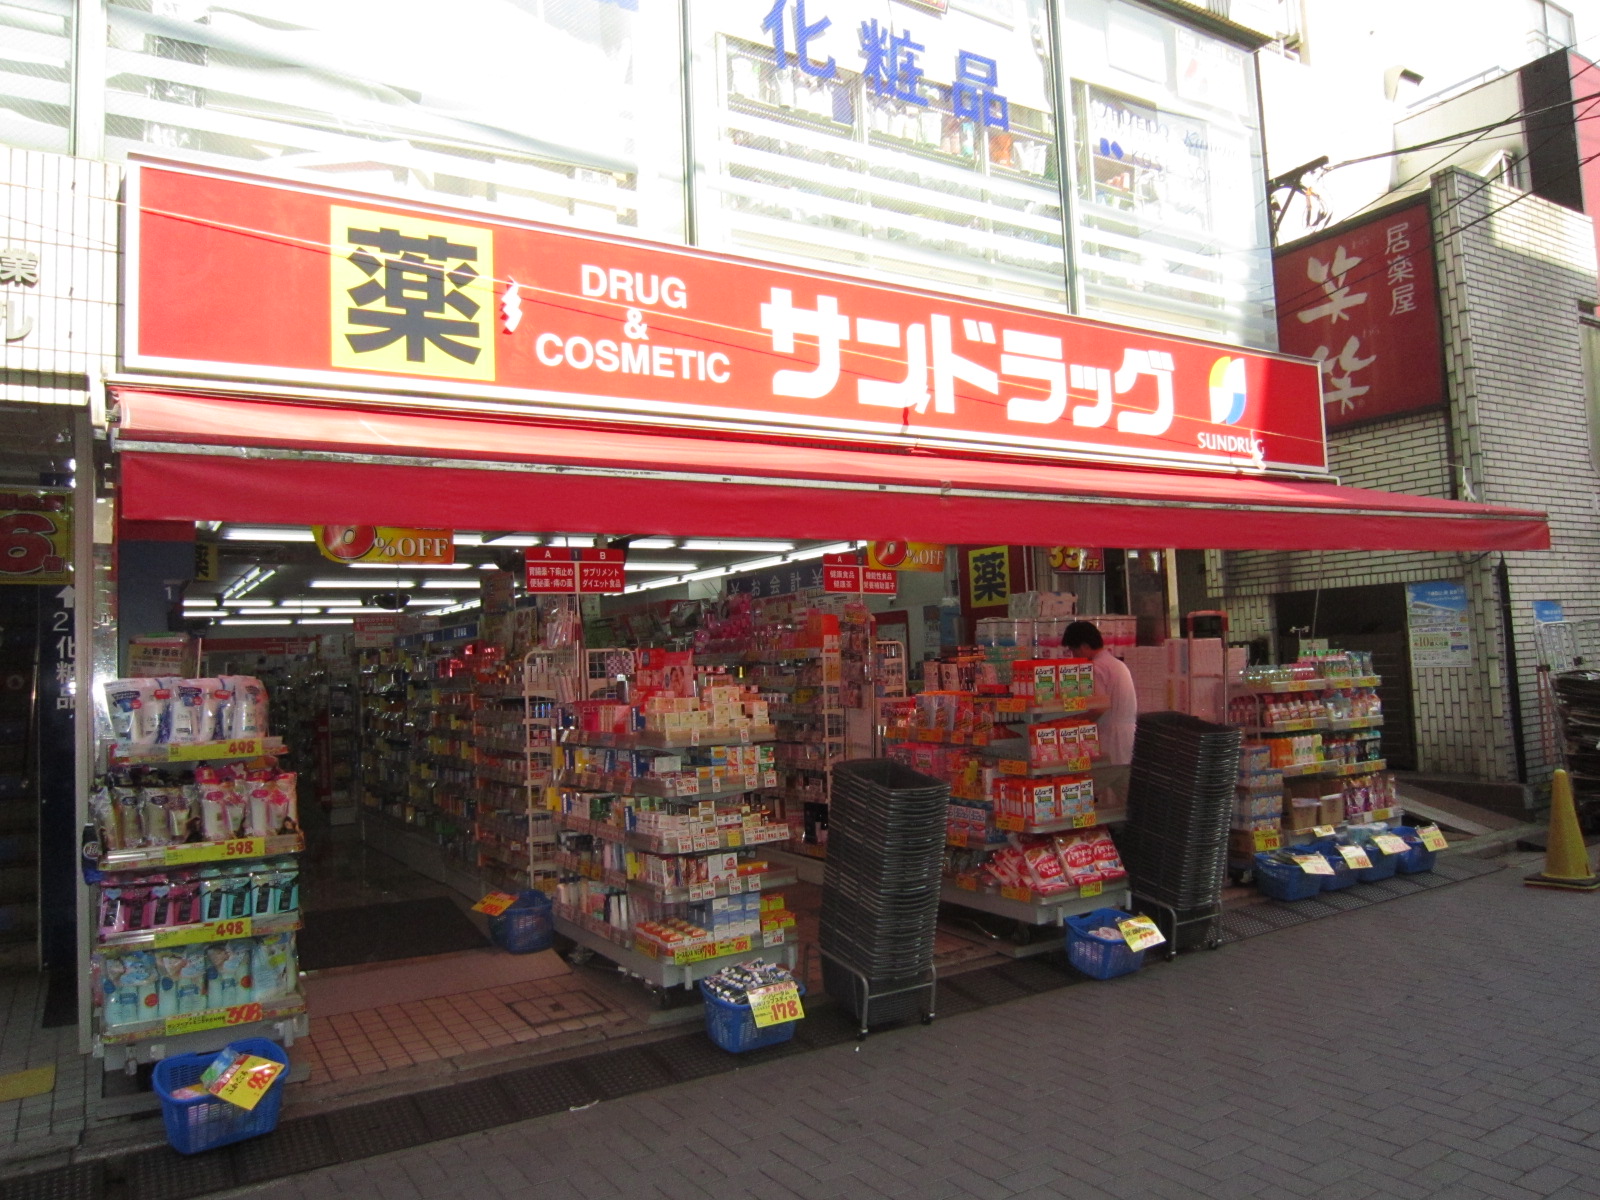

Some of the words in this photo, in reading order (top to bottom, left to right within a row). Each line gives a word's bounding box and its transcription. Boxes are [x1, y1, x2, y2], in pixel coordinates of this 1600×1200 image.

[760, 0, 1009, 132] 化粧品
[581, 264, 687, 309] DRUG
[1385, 222, 1417, 317] 居楽屋
[344, 226, 482, 366] 薬
[623, 308, 649, 341] &
[535, 333, 731, 383] COSMETIC
[760, 287, 1175, 436] サンドラッグ
[1197, 432, 1265, 456] SUNDRUG
[544, 550, 552, 559] A
[599, 551, 606, 560] B
[972, 552, 1007, 601] 薬
[228, 741, 256, 754] 498
[226, 841, 254, 855] 598
[216, 921, 245, 937] 498
[771, 1000, 799, 1020] 178
